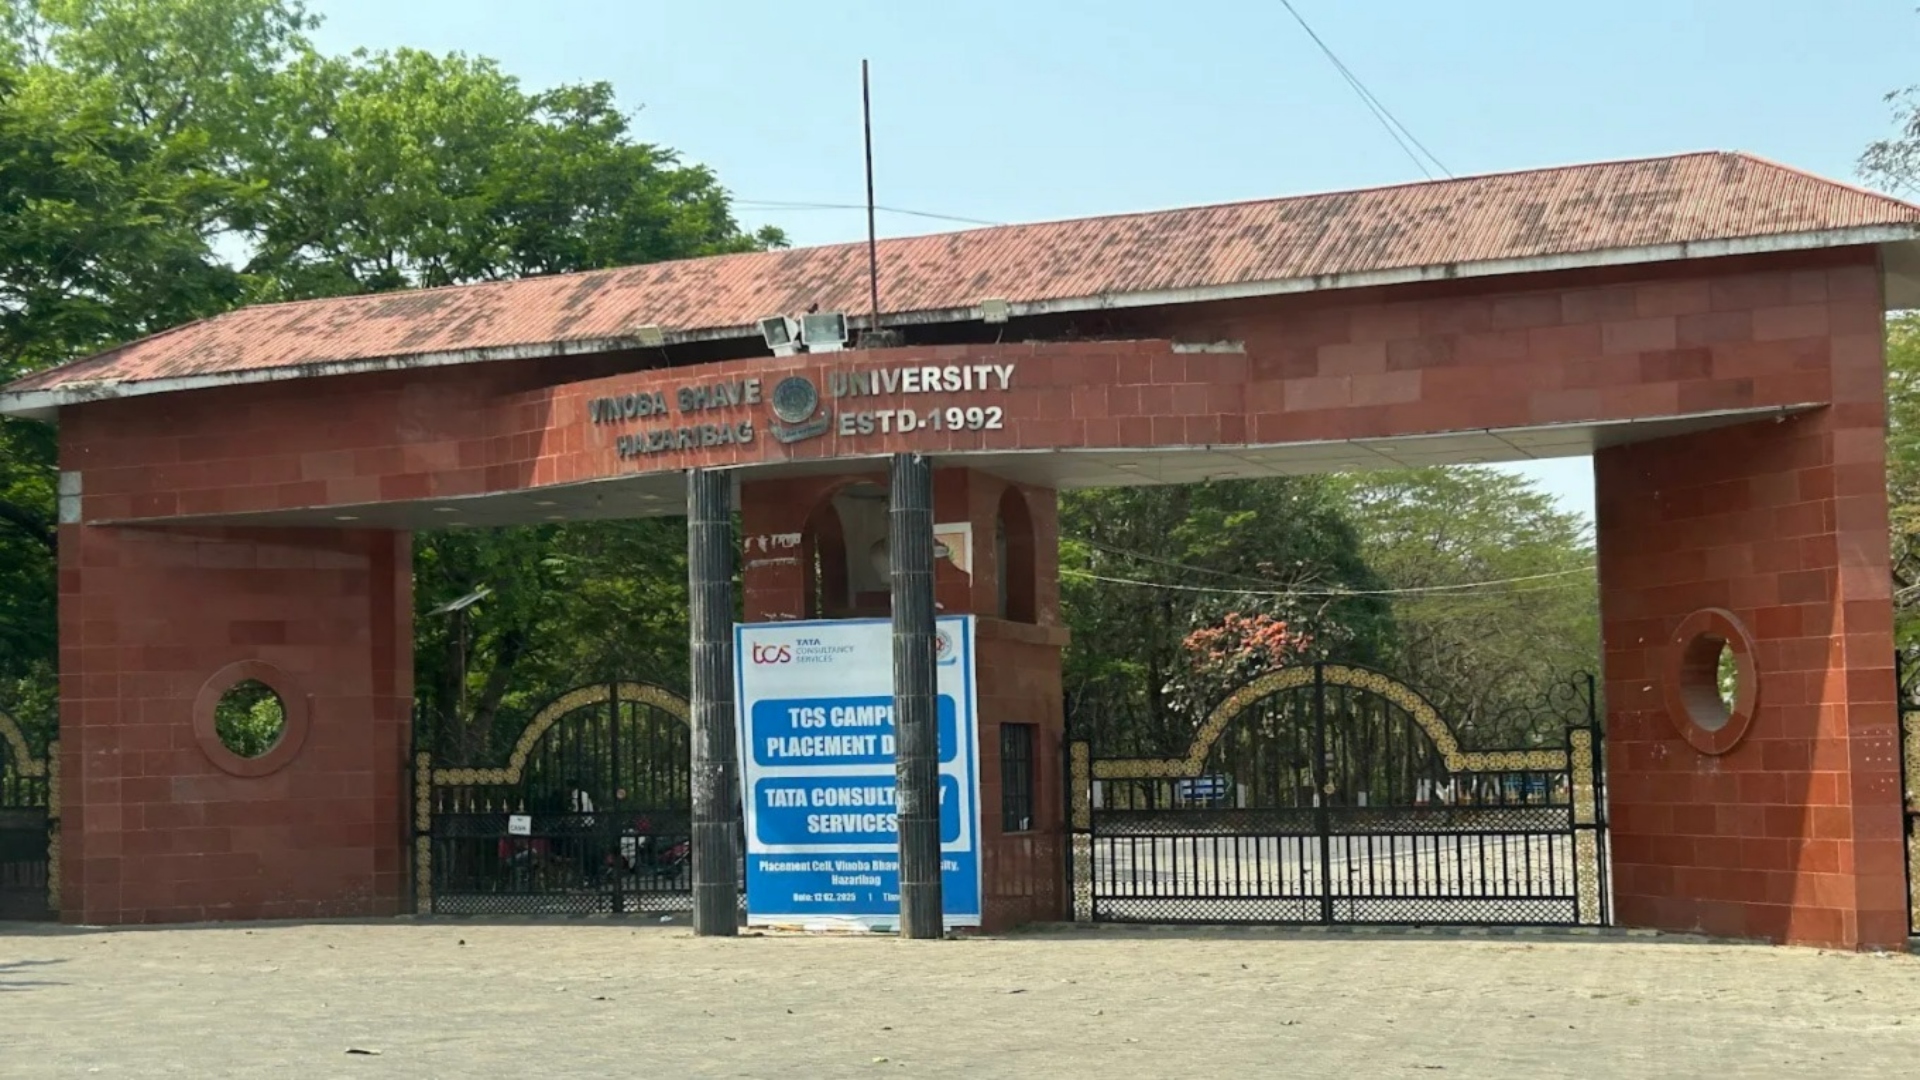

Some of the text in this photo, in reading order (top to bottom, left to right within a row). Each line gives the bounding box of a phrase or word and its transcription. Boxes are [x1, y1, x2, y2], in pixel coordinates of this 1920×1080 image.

[588, 391, 667, 424] VINOBA
[677, 378, 762, 414] BHAVE
[828, 364, 1015, 398] UNIVERSITY
[616, 420, 755, 457] HAZARIBAG
[838, 405, 1003, 436] ESTD-1992
[796, 638, 821, 646] TATA
[796, 645, 854, 655] CONSULTANCY
[753, 641, 792, 664] tcs
[796, 654, 833, 664] SERVICES
[788, 705, 895, 729] TCS CAMPU
[767, 735, 877, 758] PLACEMENT
[764, 789, 807, 808] TATA
[807, 813, 899, 834] SERVICES
[759, 860, 811, 872] Placement
[834, 860, 871, 872] Vinoba
[831, 874, 881, 886] Hazaribag
